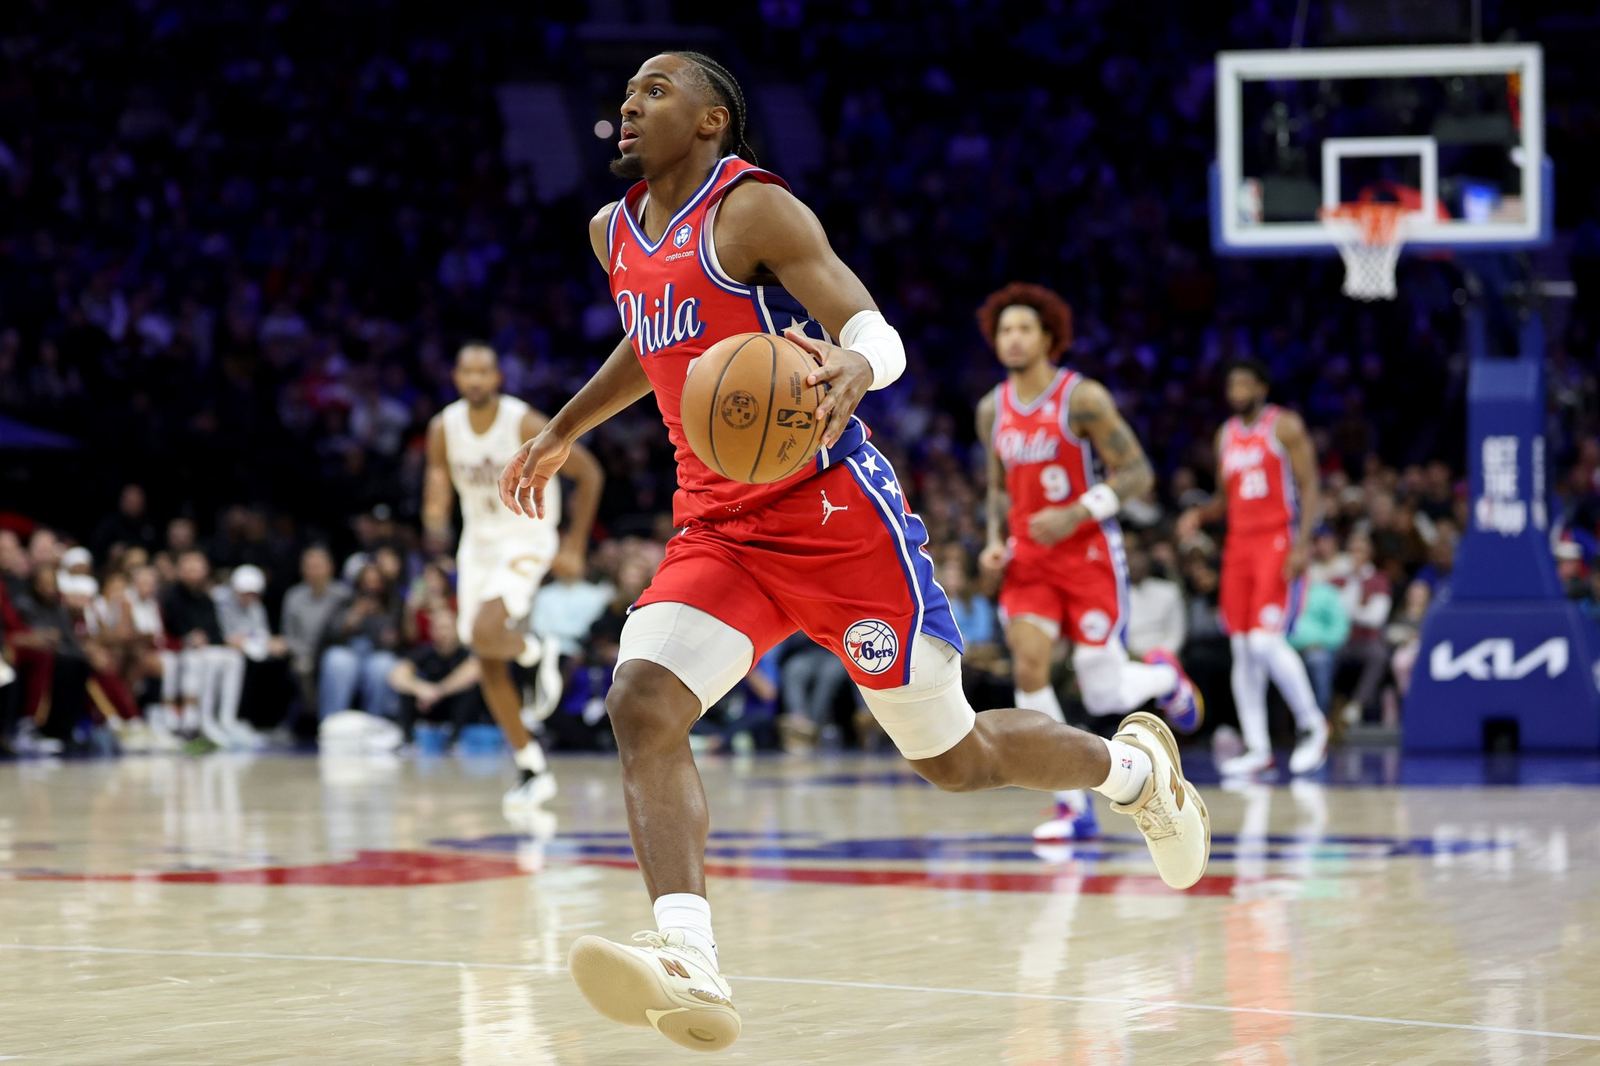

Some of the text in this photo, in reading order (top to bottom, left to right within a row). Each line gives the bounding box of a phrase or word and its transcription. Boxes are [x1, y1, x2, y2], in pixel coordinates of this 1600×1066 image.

[666, 250, 694, 262] crypto.com
[616, 282, 704, 356] Phila
[1040, 465, 1071, 502] 9
[849, 640, 894, 661] 76ers
[1430, 637, 1569, 681] KIA
[658, 956, 691, 980] N
